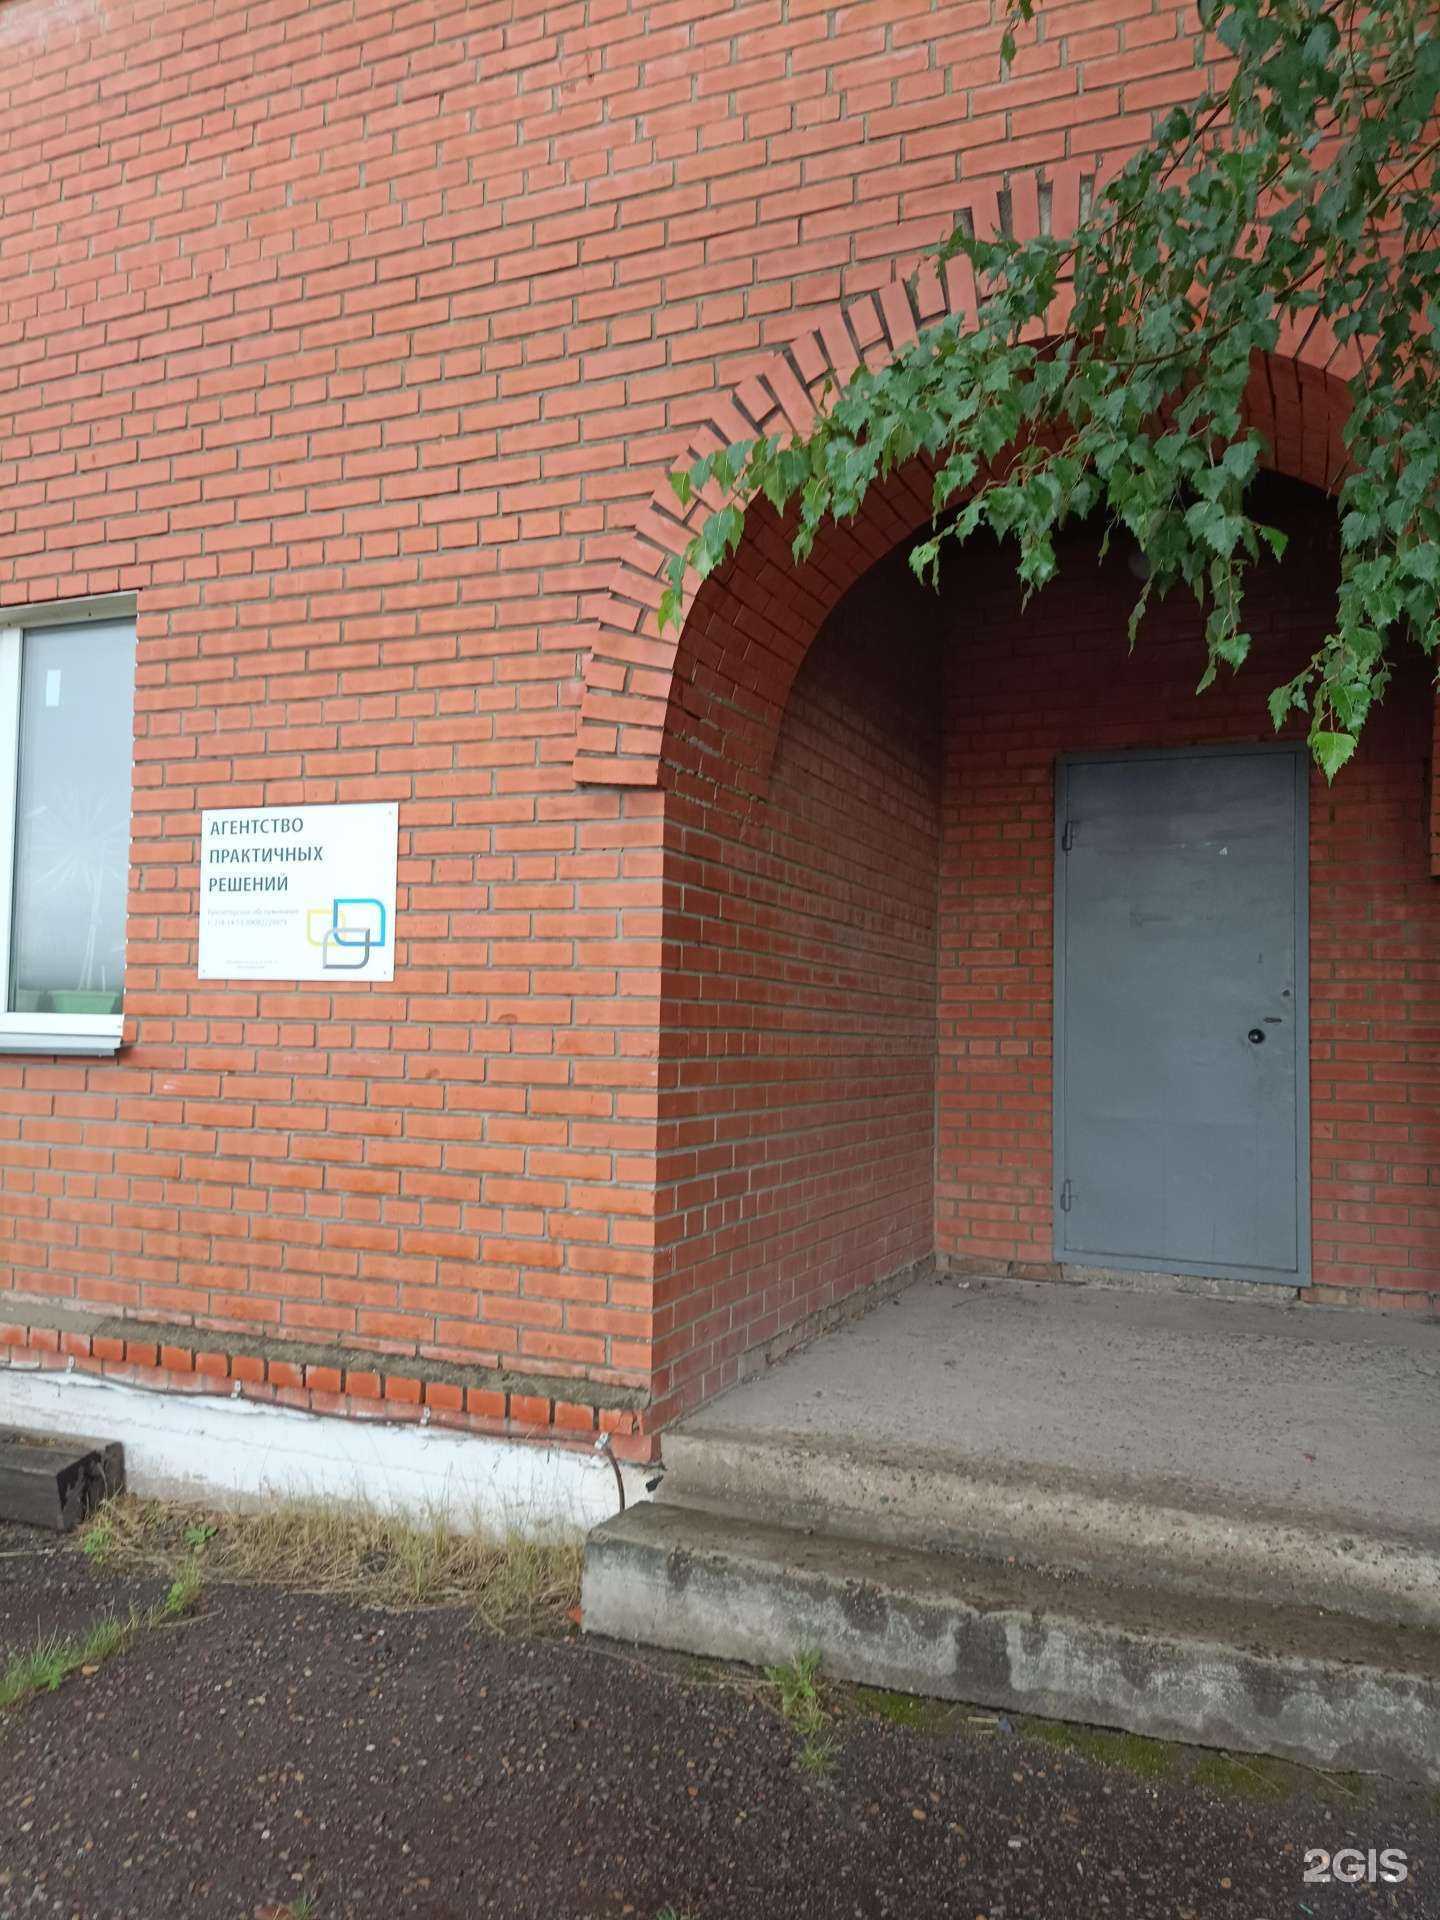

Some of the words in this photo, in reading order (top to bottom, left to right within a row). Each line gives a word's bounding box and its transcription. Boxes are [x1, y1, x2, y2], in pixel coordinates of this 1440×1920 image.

[210, 817, 304, 836] АГЕНТСТВО
[209, 846, 324, 864] ПРАКТИЧНЫХ
[209, 873, 289, 893] РЕШЕНИЙ
